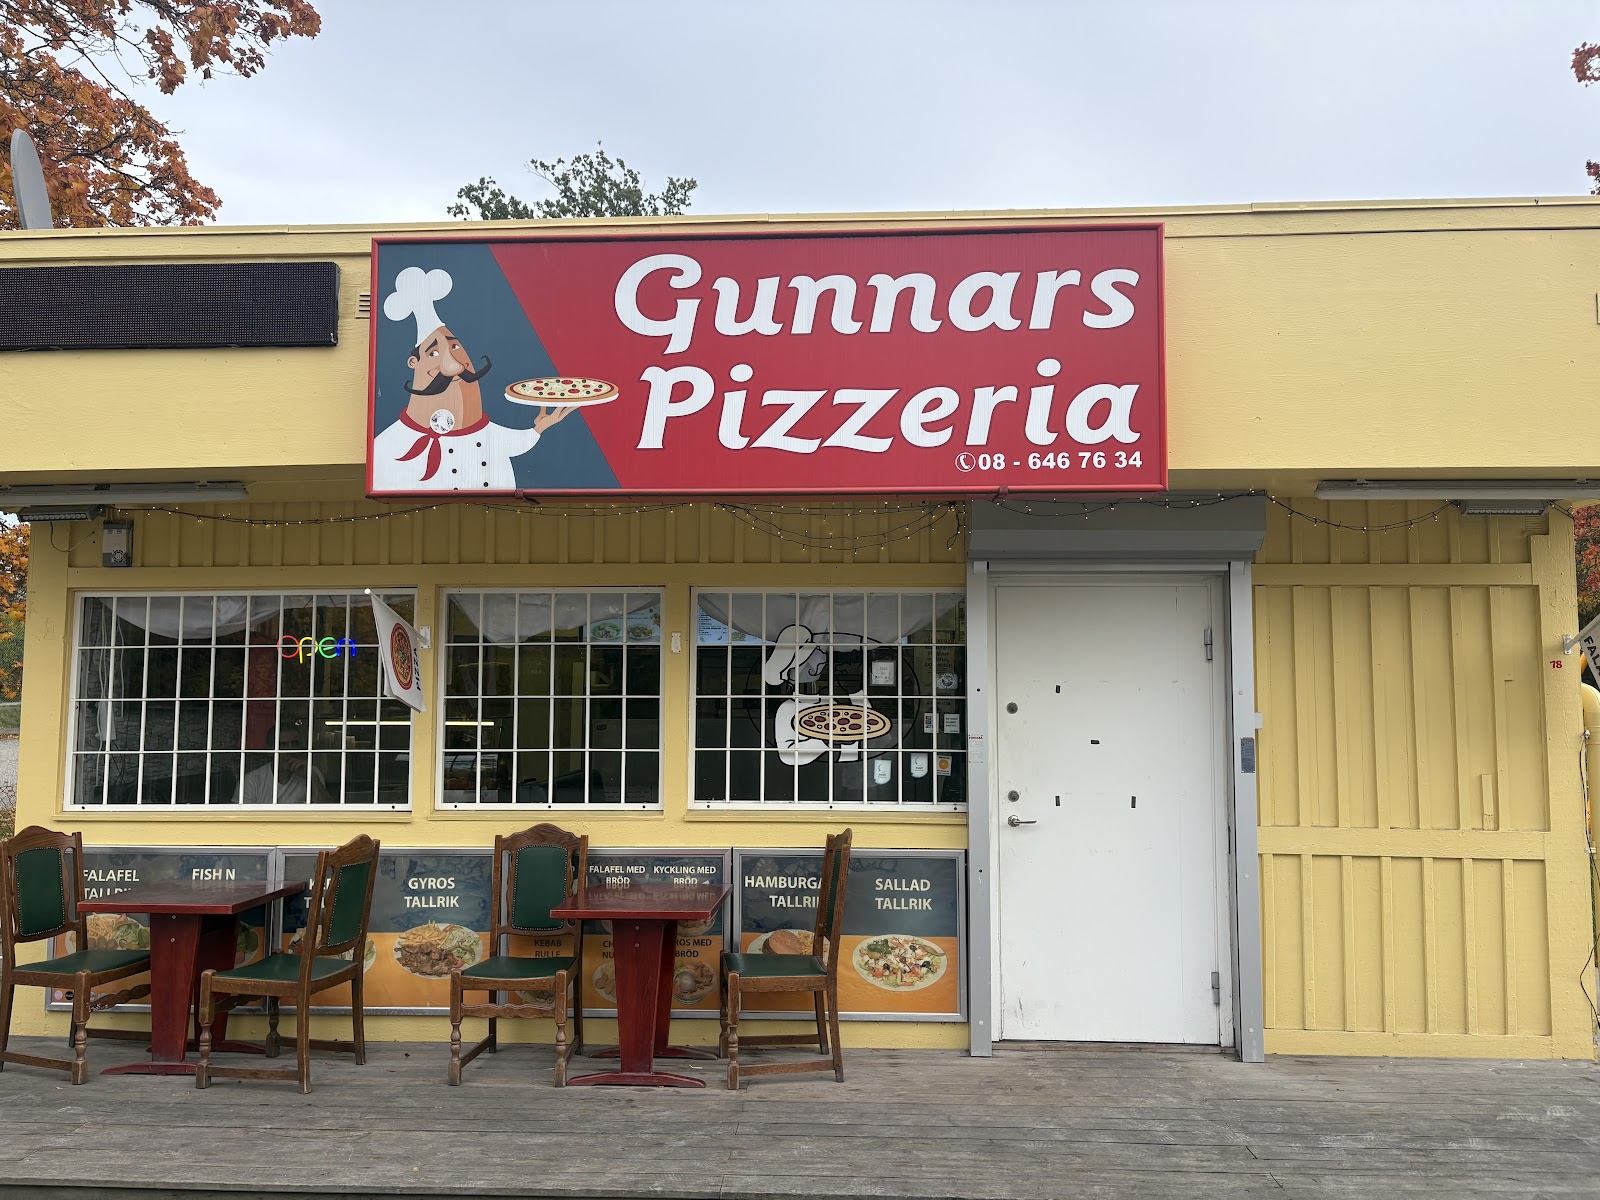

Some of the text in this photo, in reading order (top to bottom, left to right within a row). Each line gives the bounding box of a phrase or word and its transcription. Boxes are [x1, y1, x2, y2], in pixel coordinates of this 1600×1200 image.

[614, 253, 1141, 355] Gunnars
[636, 358, 1142, 454] Pizzeria
[978, 453, 1006, 471] 08
[1027, 452, 1071, 470] 646
[1078, 451, 1106, 469] 76
[1114, 451, 1143, 469] 34
[192, 869, 236, 880] FISH N
[589, 865, 646, 874] FALAFEL MED
[653, 866, 716, 875] KYCKLING MED
[408, 877, 456, 890] GYROS
[606, 875, 631, 884] BRÖD
[673, 876, 698, 884] BRÖD
[875, 878, 931, 891] SALLAD
[404, 896, 460, 908] TALLRIK
[769, 895, 820, 908] TALLRI
[875, 897, 932, 910] TALLRIK
[534, 939, 562, 947] KEBAB
[675, 938, 712, 947] ROS MED
[534, 950, 561, 958] RULLE
